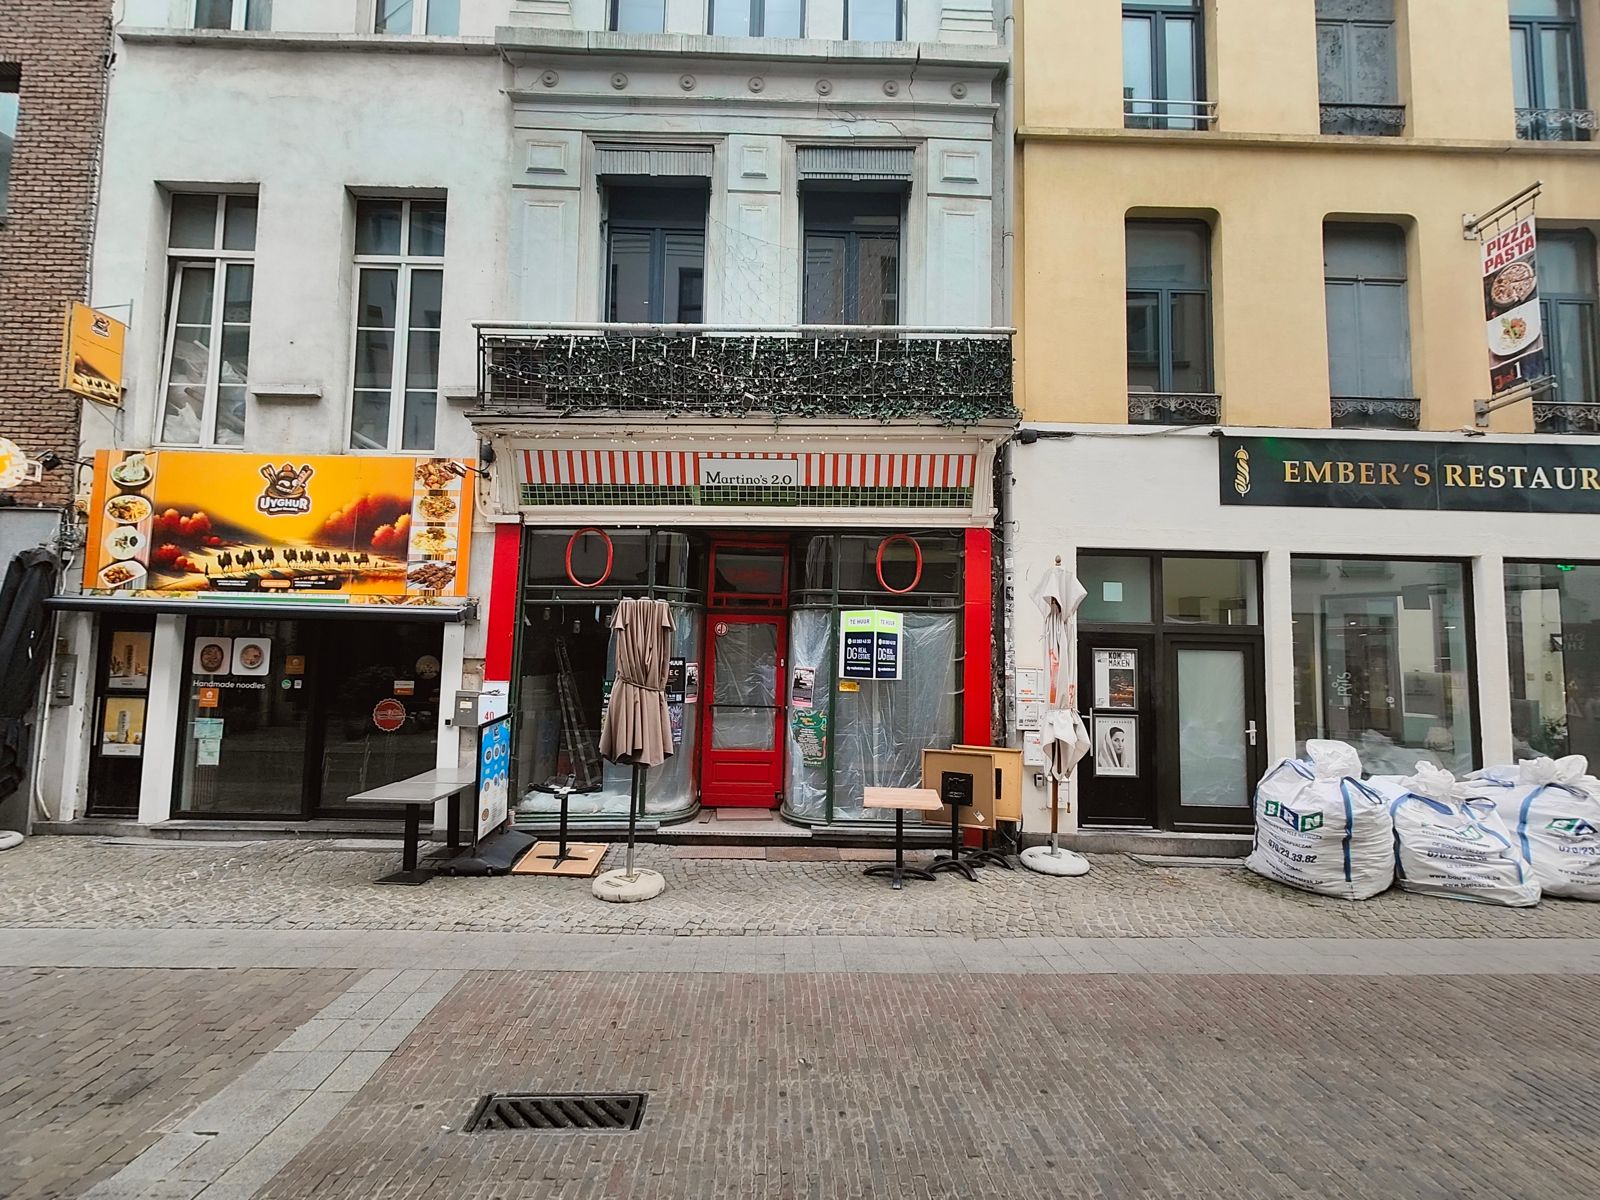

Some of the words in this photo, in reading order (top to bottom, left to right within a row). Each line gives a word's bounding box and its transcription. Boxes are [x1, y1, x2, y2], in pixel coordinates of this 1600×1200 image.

[1486, 221, 1531, 257] PIZZA
[1484, 236, 1535, 274] PASTA
[705, 471, 768, 485] Martino's
[771, 474, 792, 485] 2.0
[1283, 460, 1431, 487] EMBER'S
[1444, 464, 1600, 490] RESTAUR
[260, 497, 308, 510] UYGHUR
[847, 647, 857, 660] DG
[878, 648, 886, 660] DG
[192, 680, 235, 688] Handmade
[484, 711, 495, 722] 40
[1266, 803, 1320, 829] BRN
